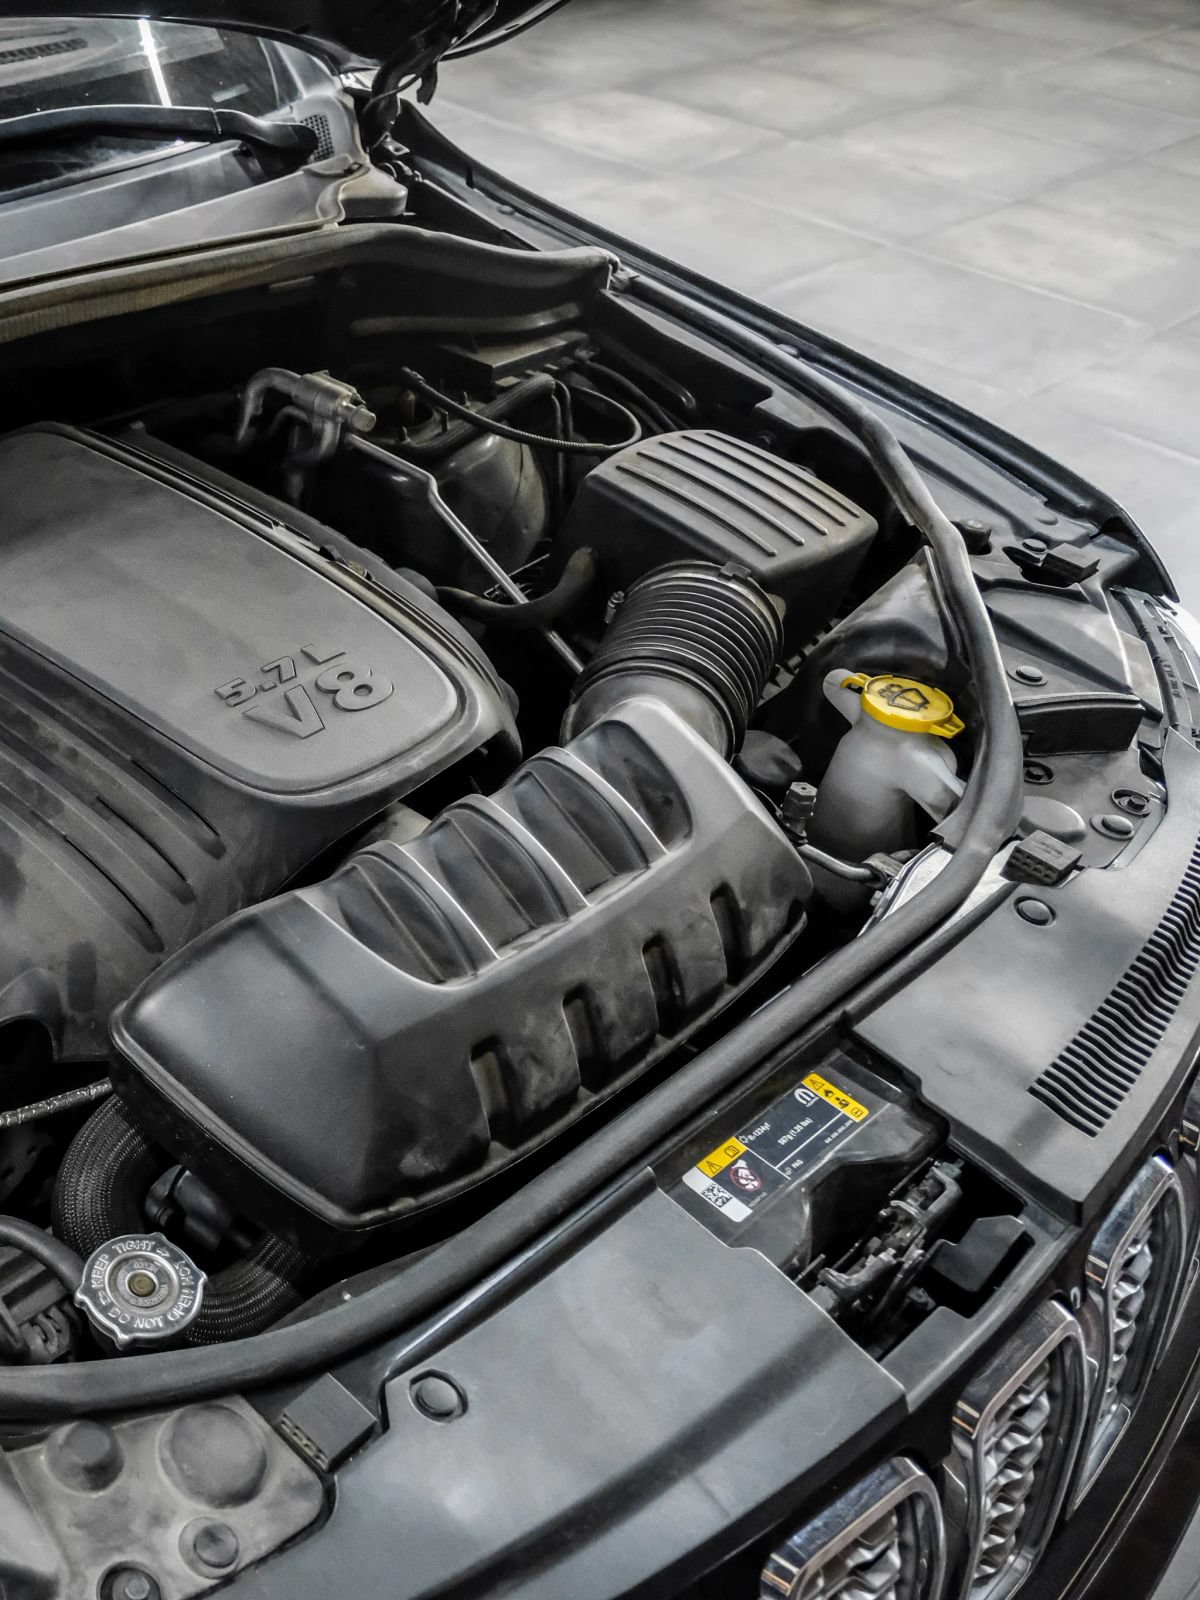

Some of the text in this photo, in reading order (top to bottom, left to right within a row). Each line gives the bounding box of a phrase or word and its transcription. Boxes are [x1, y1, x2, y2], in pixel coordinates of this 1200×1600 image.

[241, 663, 394, 739] V8
[91, 1253, 109, 1288] KEEP
[112, 1239, 156, 1255] TIGHT
[173, 1260, 195, 1288] HOT
[107, 1307, 131, 1324] DO
[167, 1289, 195, 1322] OPEN
[133, 1315, 165, 1329] NOT
